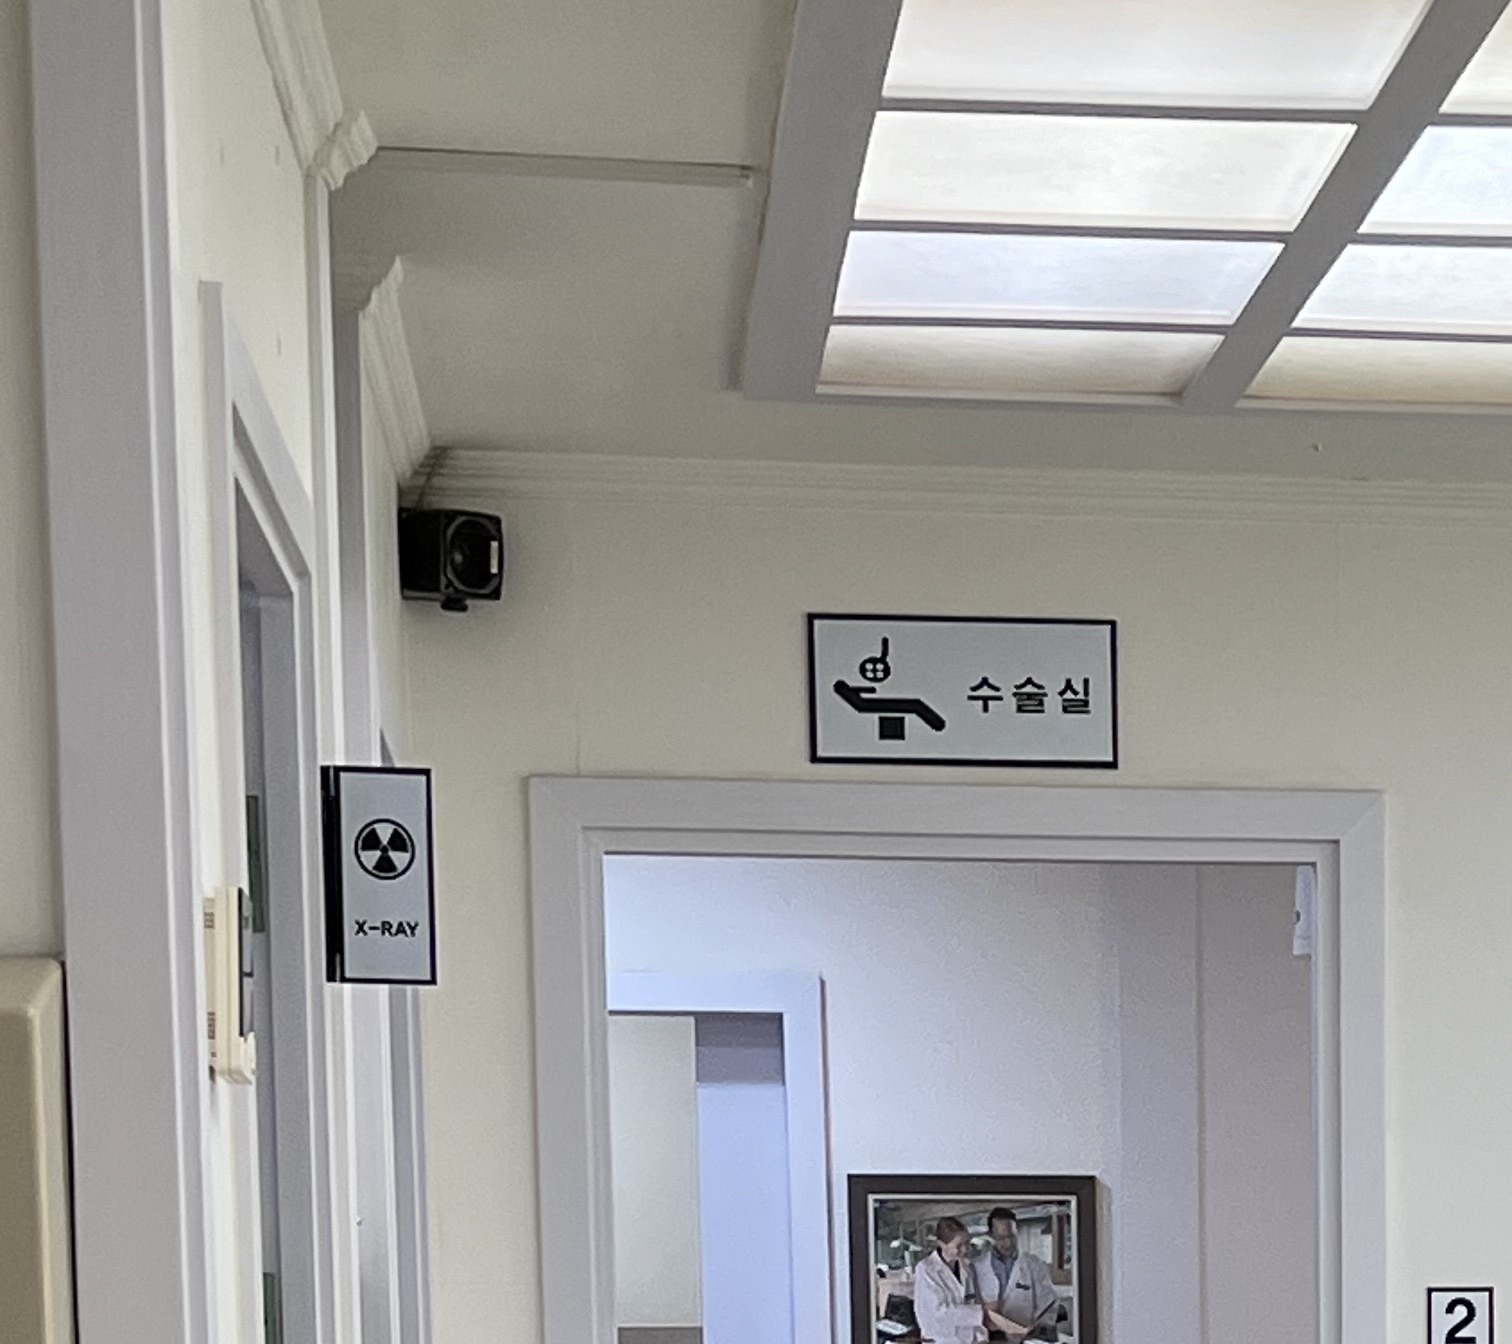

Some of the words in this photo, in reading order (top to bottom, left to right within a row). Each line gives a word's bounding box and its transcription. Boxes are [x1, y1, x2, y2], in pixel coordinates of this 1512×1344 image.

[967, 676, 1092, 715] 수술실
[354, 919, 420, 938] X-RAY
[1445, 1297, 1477, 1344] 2
